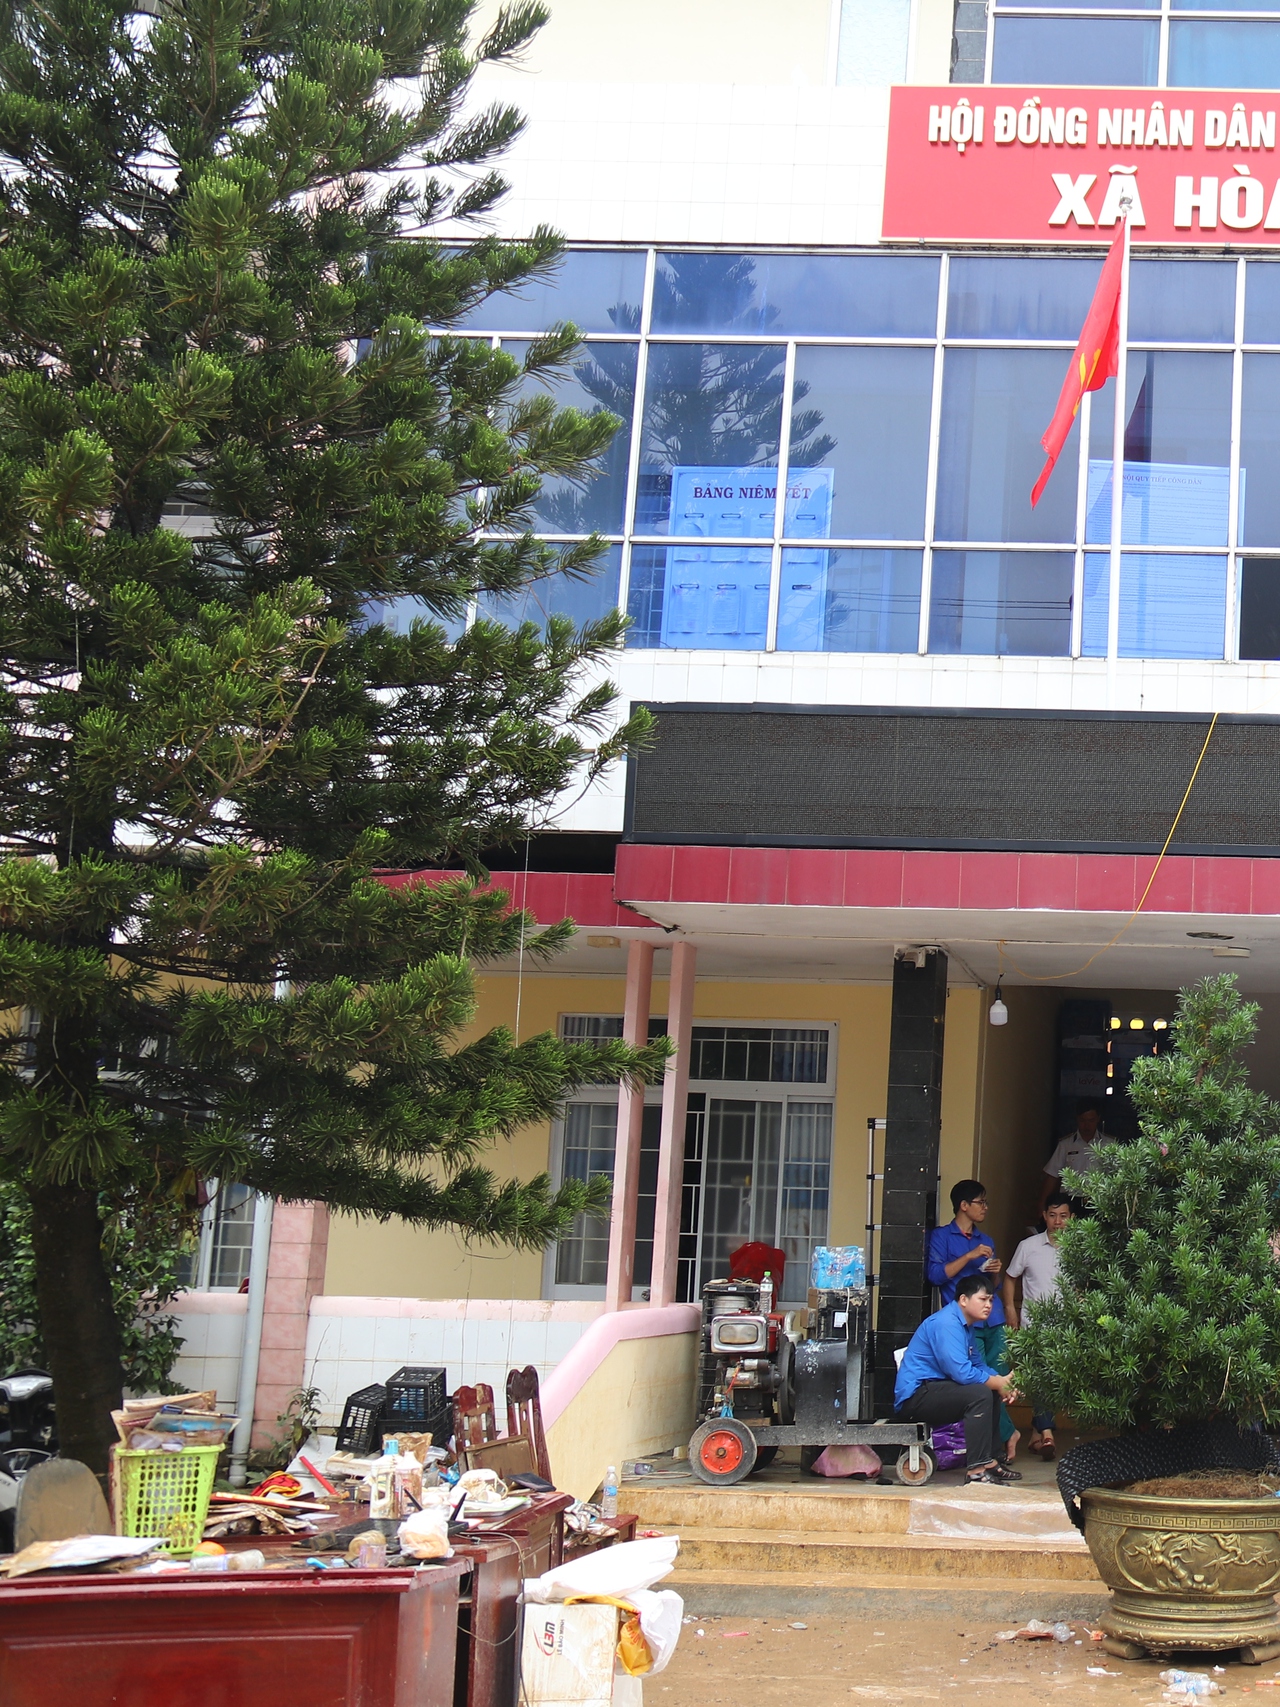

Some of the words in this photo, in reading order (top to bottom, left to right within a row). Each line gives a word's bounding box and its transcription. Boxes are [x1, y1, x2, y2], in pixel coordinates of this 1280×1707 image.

[927, 97, 985, 155] HỘI
[993, 96, 1089, 147] ĐỒNG
[1097, 100, 1195, 149] NHÂN
[1203, 102, 1276, 150] DÂN
[1047, 163, 1147, 228] XÃ
[693, 482, 734, 499] BẢNG
[738, 484, 777, 499] NIÊM
